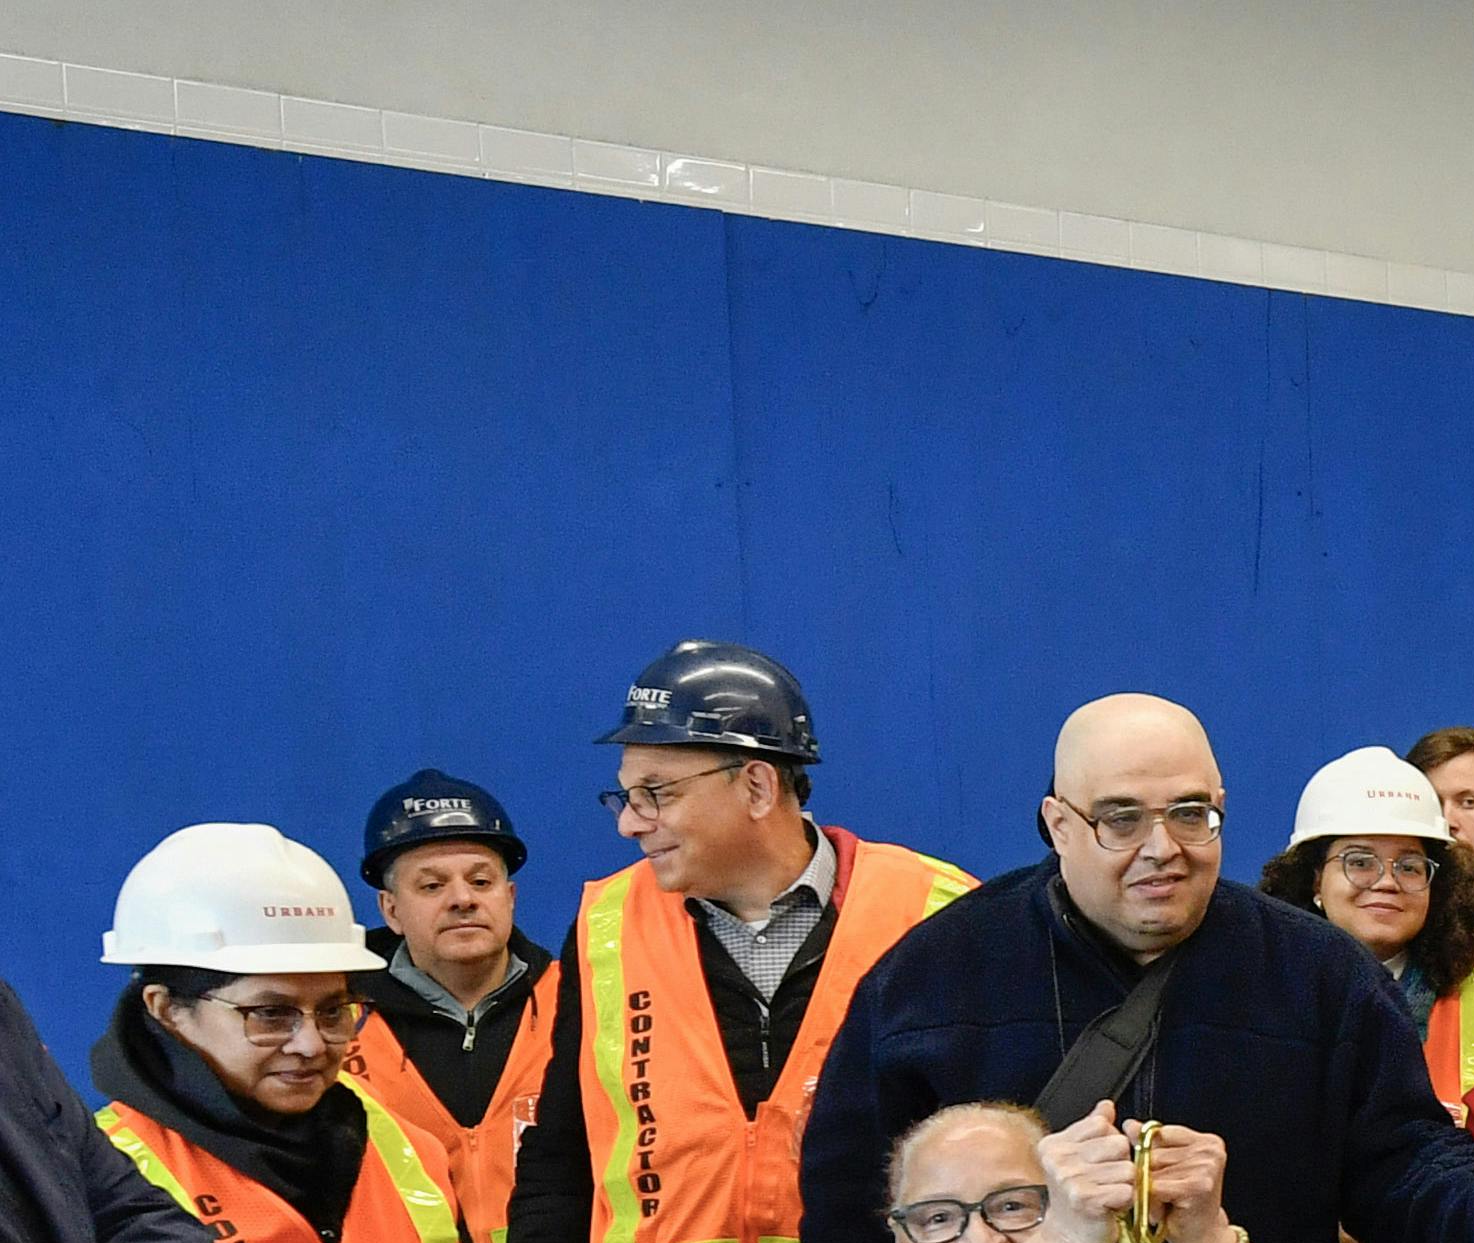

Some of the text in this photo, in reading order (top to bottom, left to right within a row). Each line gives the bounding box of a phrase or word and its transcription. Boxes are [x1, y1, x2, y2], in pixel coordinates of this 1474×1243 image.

[627, 685, 672, 704] FORTE
[413, 798, 472, 811] FORTE
[629, 990, 661, 1218] CONTRACTOR
